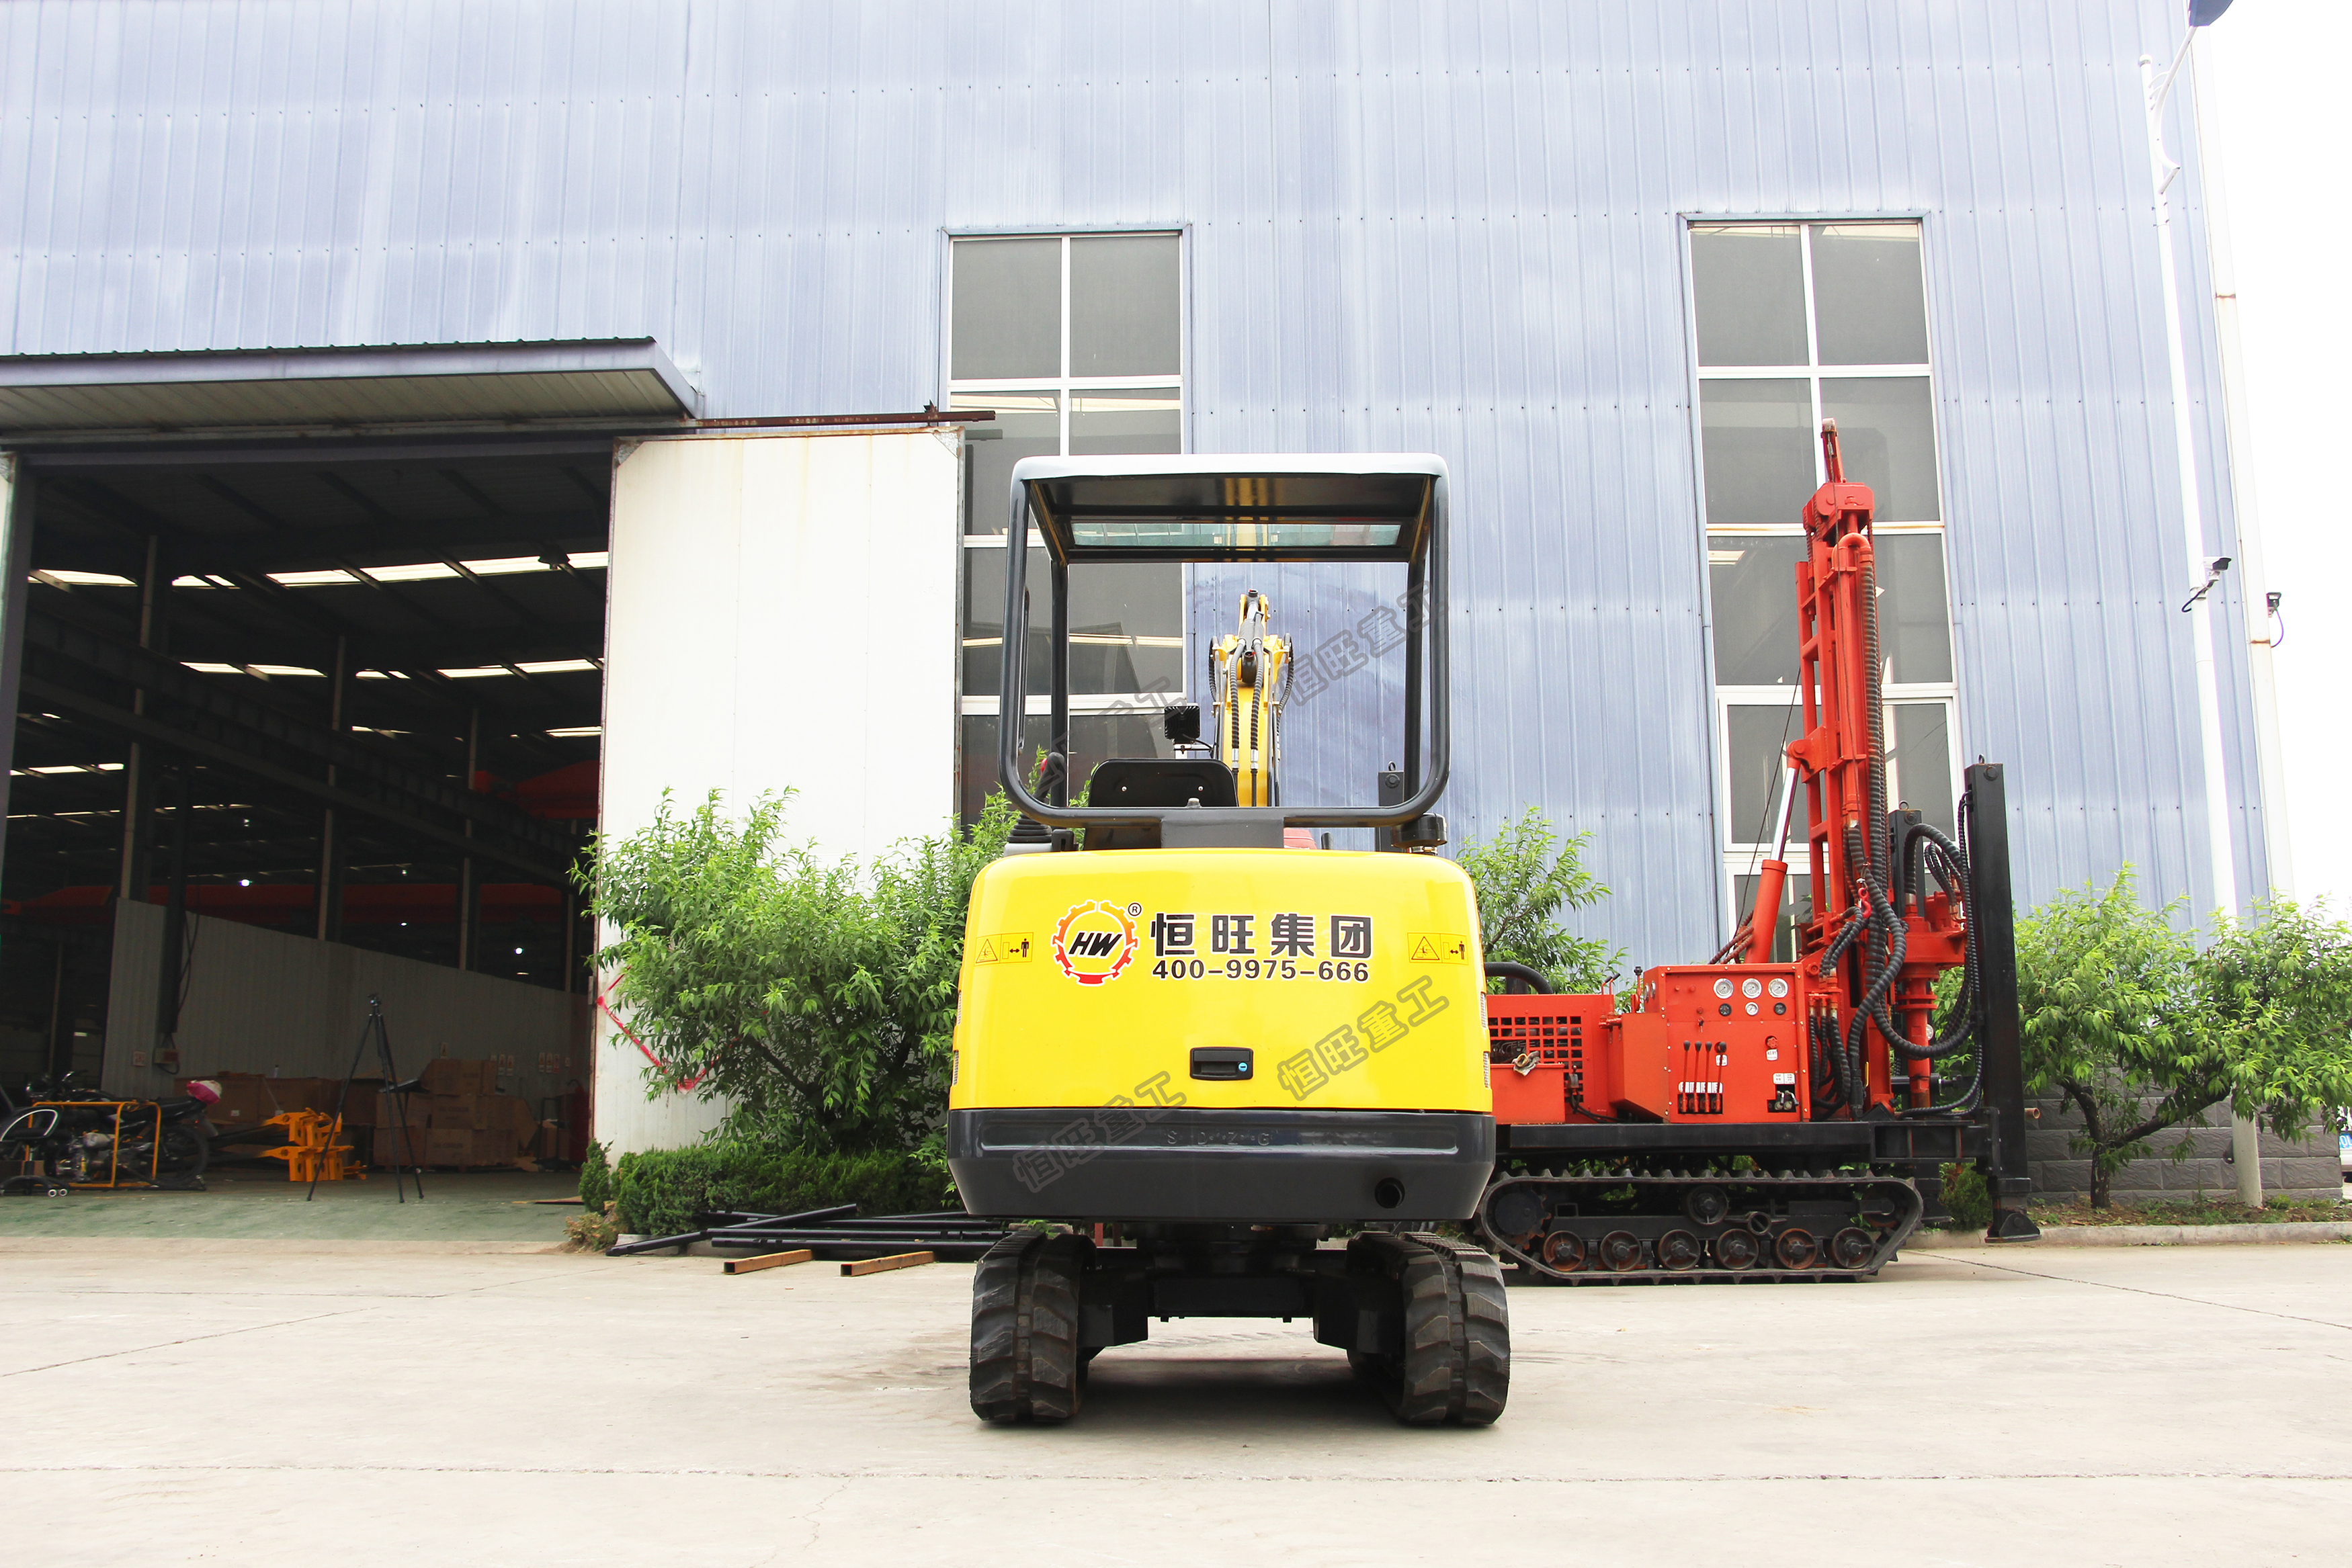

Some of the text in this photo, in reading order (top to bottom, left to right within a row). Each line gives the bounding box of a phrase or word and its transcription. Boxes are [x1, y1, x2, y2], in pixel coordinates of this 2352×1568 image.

[1068, 932, 1123, 957] HW
[1151, 913, 1372, 958] 恒旺集团
[1152, 959, 1369, 981] 400-9975-666
